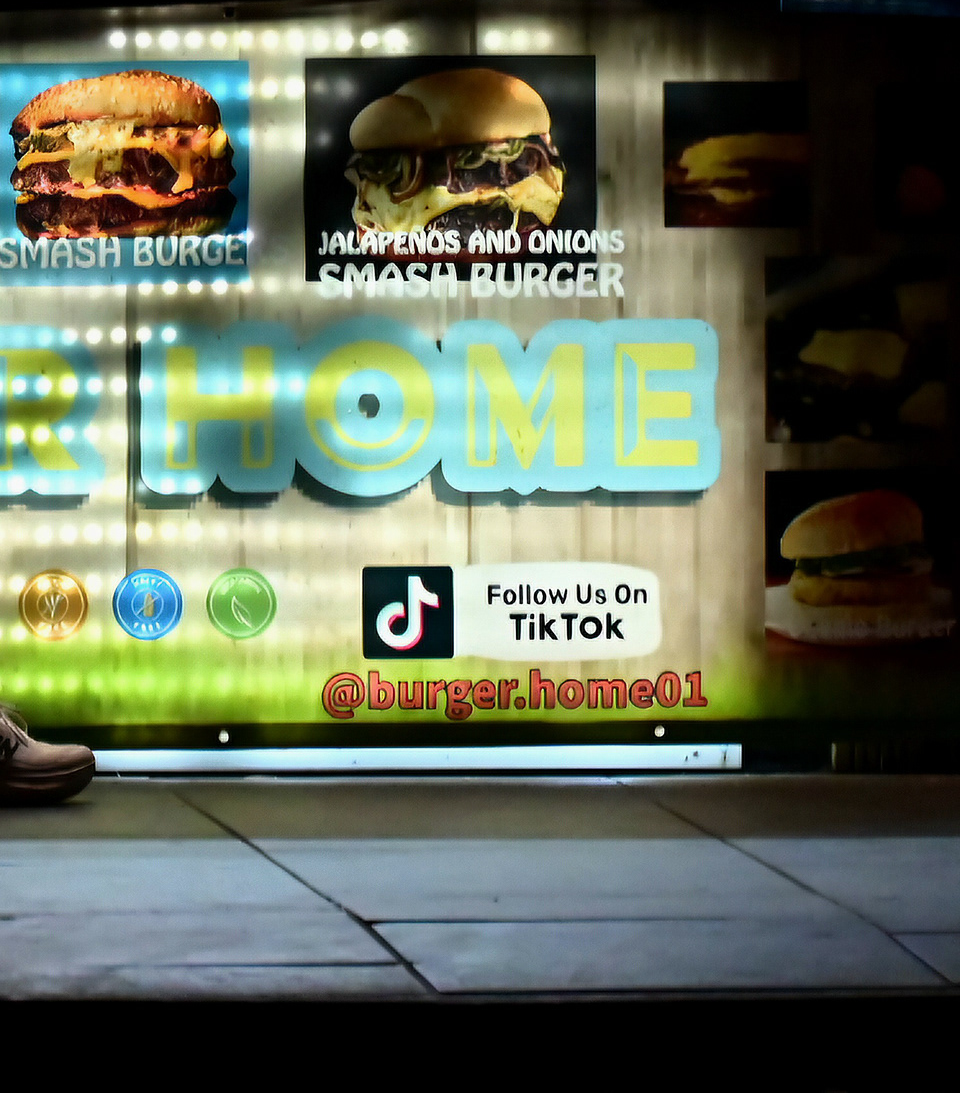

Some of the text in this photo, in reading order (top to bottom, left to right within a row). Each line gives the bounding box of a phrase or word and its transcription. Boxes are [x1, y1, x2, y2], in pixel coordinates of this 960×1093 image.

[133, 234, 248, 267] BURGE
[467, 228, 522, 255] AND
[528, 228, 625, 255] ONIONS
[319, 262, 625, 299] SMASH BURGER
[163, 340, 700, 472] HOME
[487, 584, 648, 604] Follow Us On
[509, 612, 625, 641] TikTok
[322, 669, 709, 720] @burger.home01
